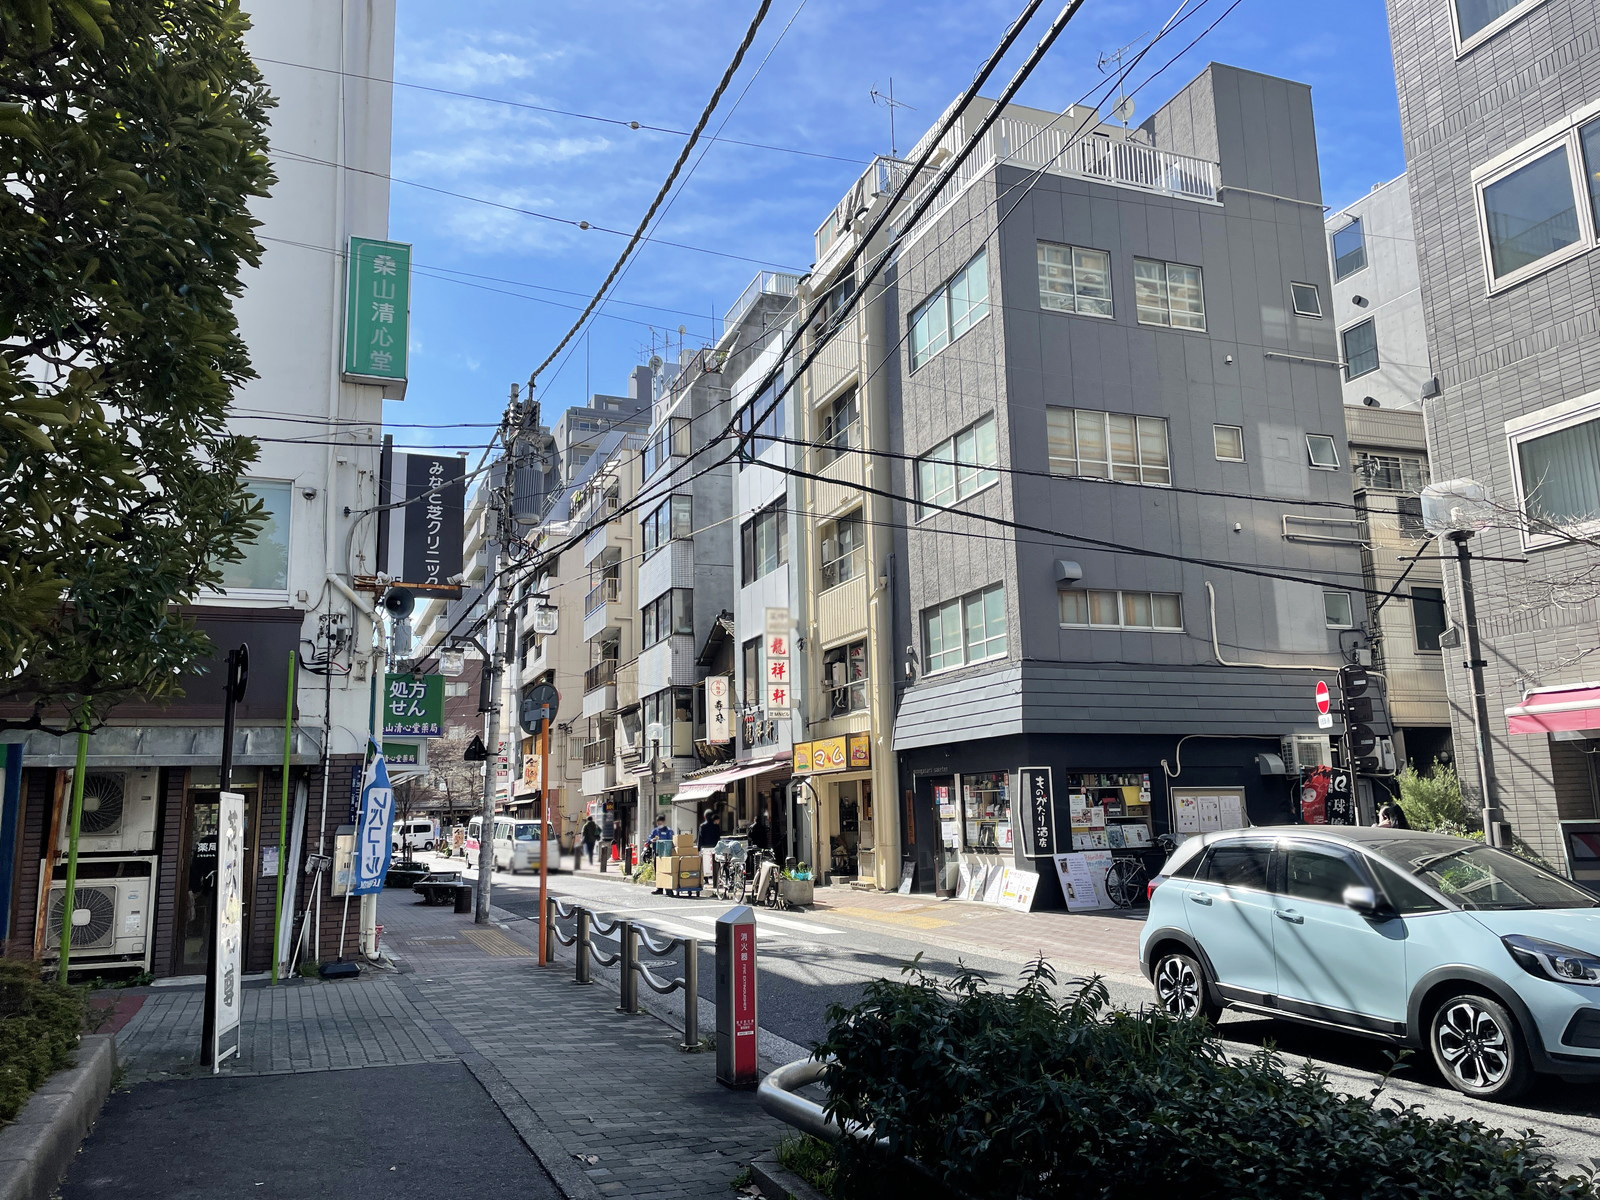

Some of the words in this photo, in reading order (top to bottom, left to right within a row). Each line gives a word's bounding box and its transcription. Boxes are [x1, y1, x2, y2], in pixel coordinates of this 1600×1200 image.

[370, 254, 396, 372] 桑山清心堂
[770, 637, 787, 705] 龍祥軒
[389, 680, 427, 699] 処方
[389, 700, 426, 717] せん
[382, 722, 438, 734] 山清心堂薬局
[1035, 775, 1049, 848] ものがたり酒店
[197, 842, 217, 852] 薬局
